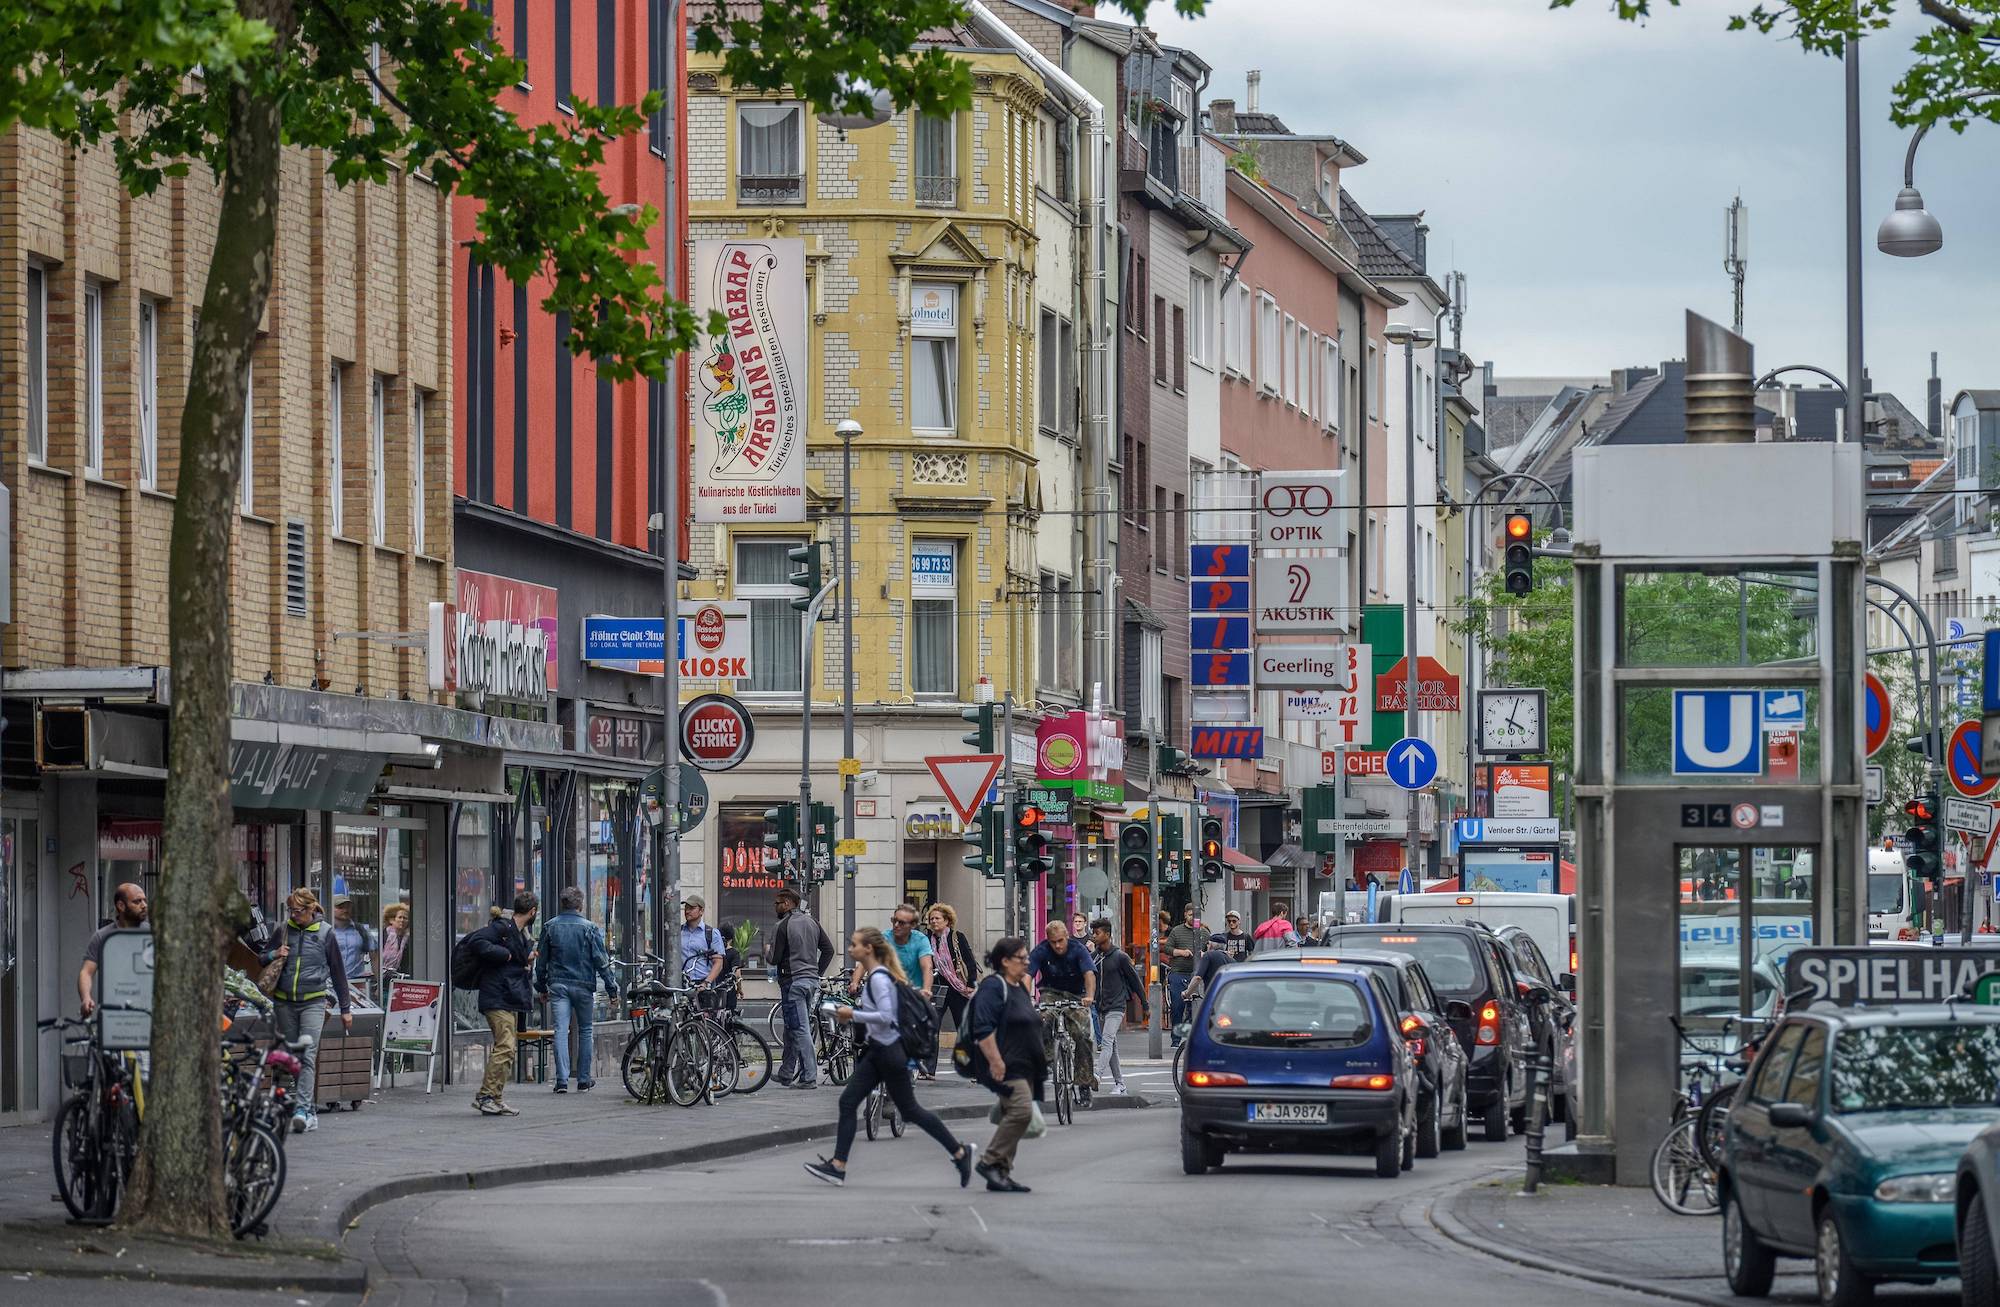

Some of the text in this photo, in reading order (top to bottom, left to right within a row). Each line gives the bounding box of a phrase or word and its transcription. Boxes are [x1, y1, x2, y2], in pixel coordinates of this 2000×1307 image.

[755, 271, 772, 333] Restaurant
[727, 251, 776, 468] ARSLAN'S KEBAP
[767, 415, 794, 474] Türkisches
[698, 485, 801, 497] Kulinarische Köstlichkeiten
[722, 503, 777, 514] aus der Türkei
[1270, 526, 1322, 540] OPTIK
[1262, 607, 1335, 621] AKUSTIK
[679, 657, 747, 677] KIOSK
[1263, 658, 1334, 677] Geerling
[1288, 697, 1320, 706] PUNKT
[694, 719, 736, 733] LUCKY
[1682, 695, 1753, 768] U
[692, 733, 737, 748] STRIKE
[1193, 729, 1261, 754] MIT!
[1322, 756, 1387, 773] BCHE
[1030, 790, 1057, 801] BED &
[1688, 808, 1725, 823] 3 4
[1332, 822, 1391, 832] Ehrenfeldgürtel
[1462, 820, 1479, 839] U
[1488, 826, 1515, 834] Venloer
[722, 875, 784, 888] Sandwich
[1257, 1105, 1325, 1118] K JA 9874
